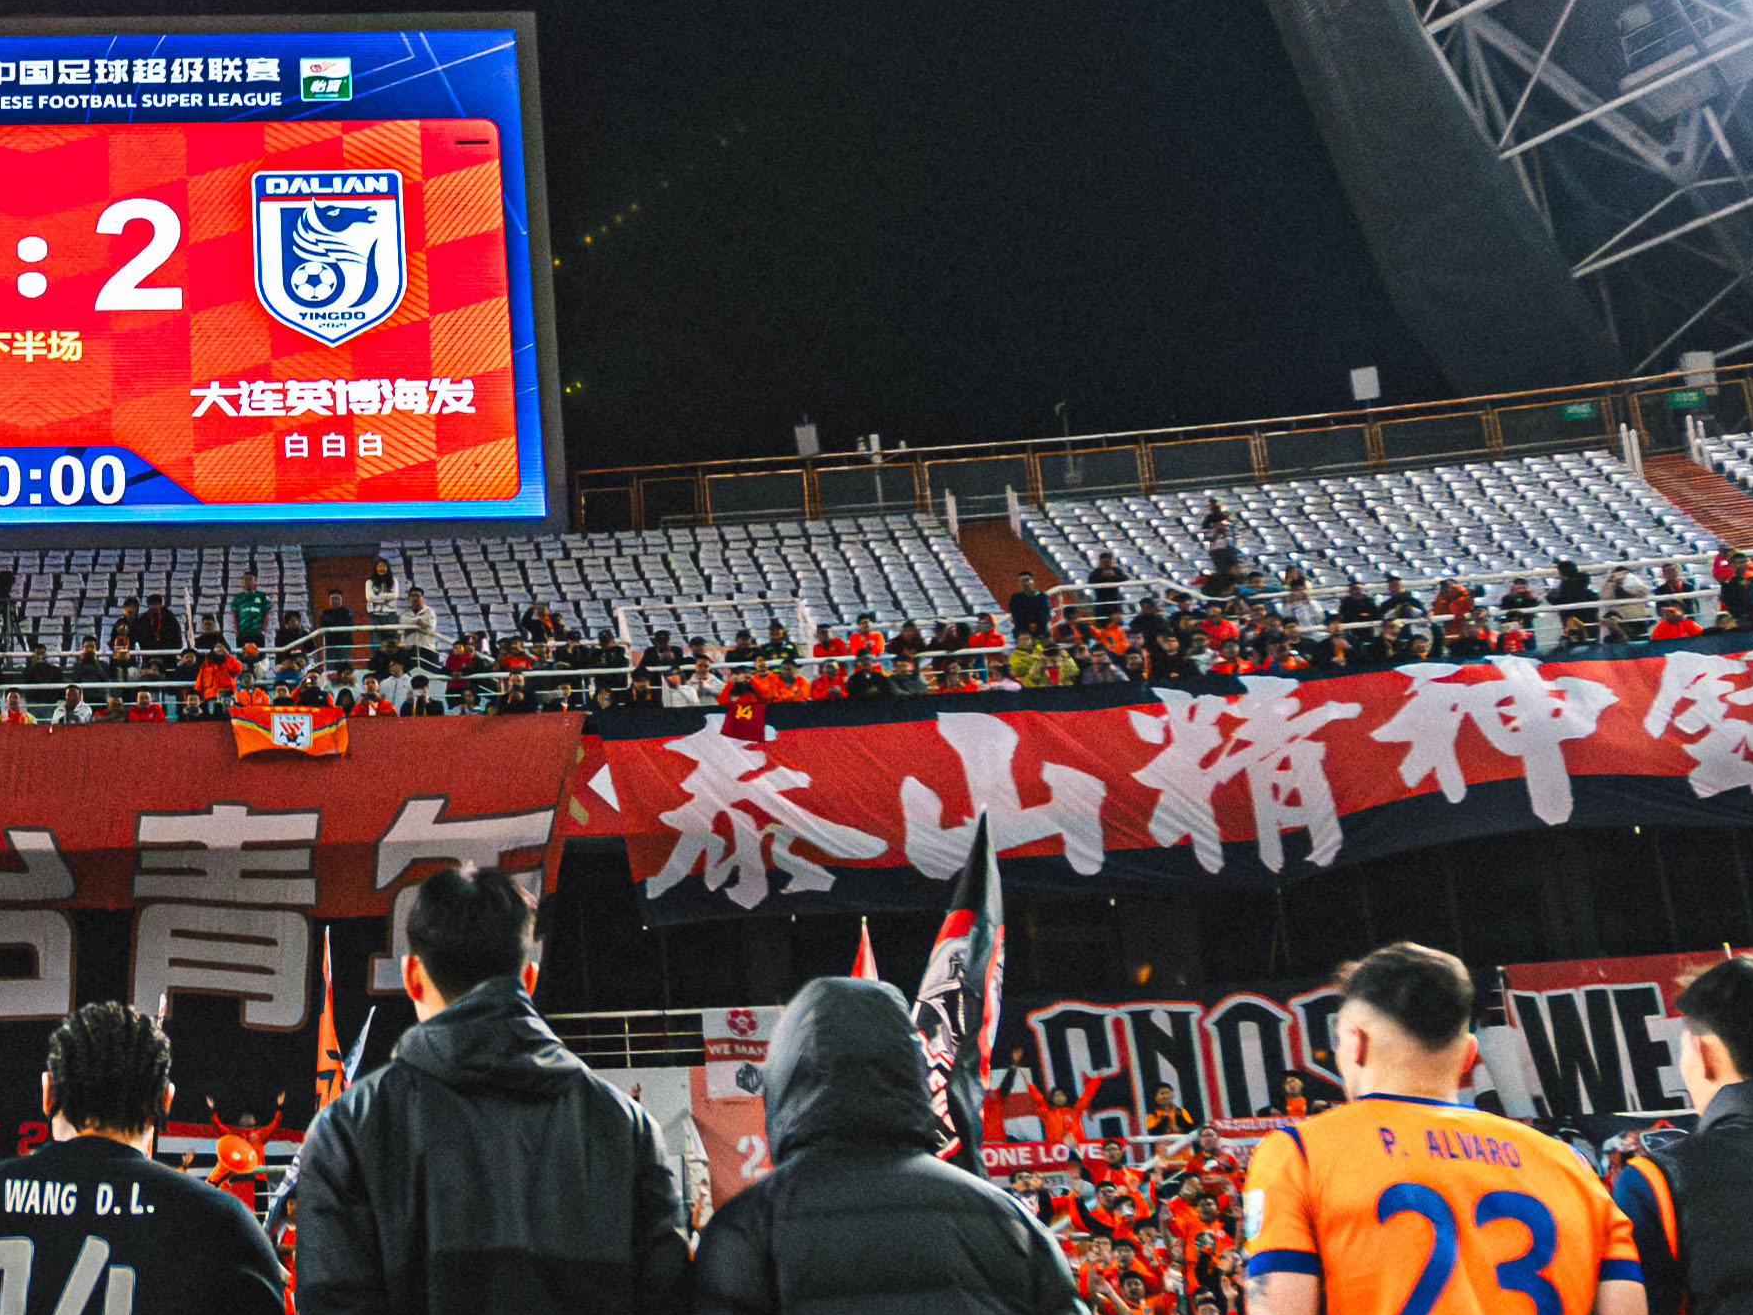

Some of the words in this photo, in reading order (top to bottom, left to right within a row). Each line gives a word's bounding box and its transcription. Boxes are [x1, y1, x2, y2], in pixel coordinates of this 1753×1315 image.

[39, 94, 137, 109] FOOTBALL
[142, 93, 203, 108] SUPER
[208, 92, 282, 107] LEAGUE
[265, 176, 389, 194] DALIAN
[94, 197, 183, 311] 2
[189, 377, 476, 418] 大连英博海发
[1510, 982, 1688, 1117] WE
[981, 1146, 1033, 1167] ONE
[1381, 1127, 1410, 1158] P.
[1425, 1128, 1523, 1169] ALVARO
[4, 1178, 77, 1216] WANG
